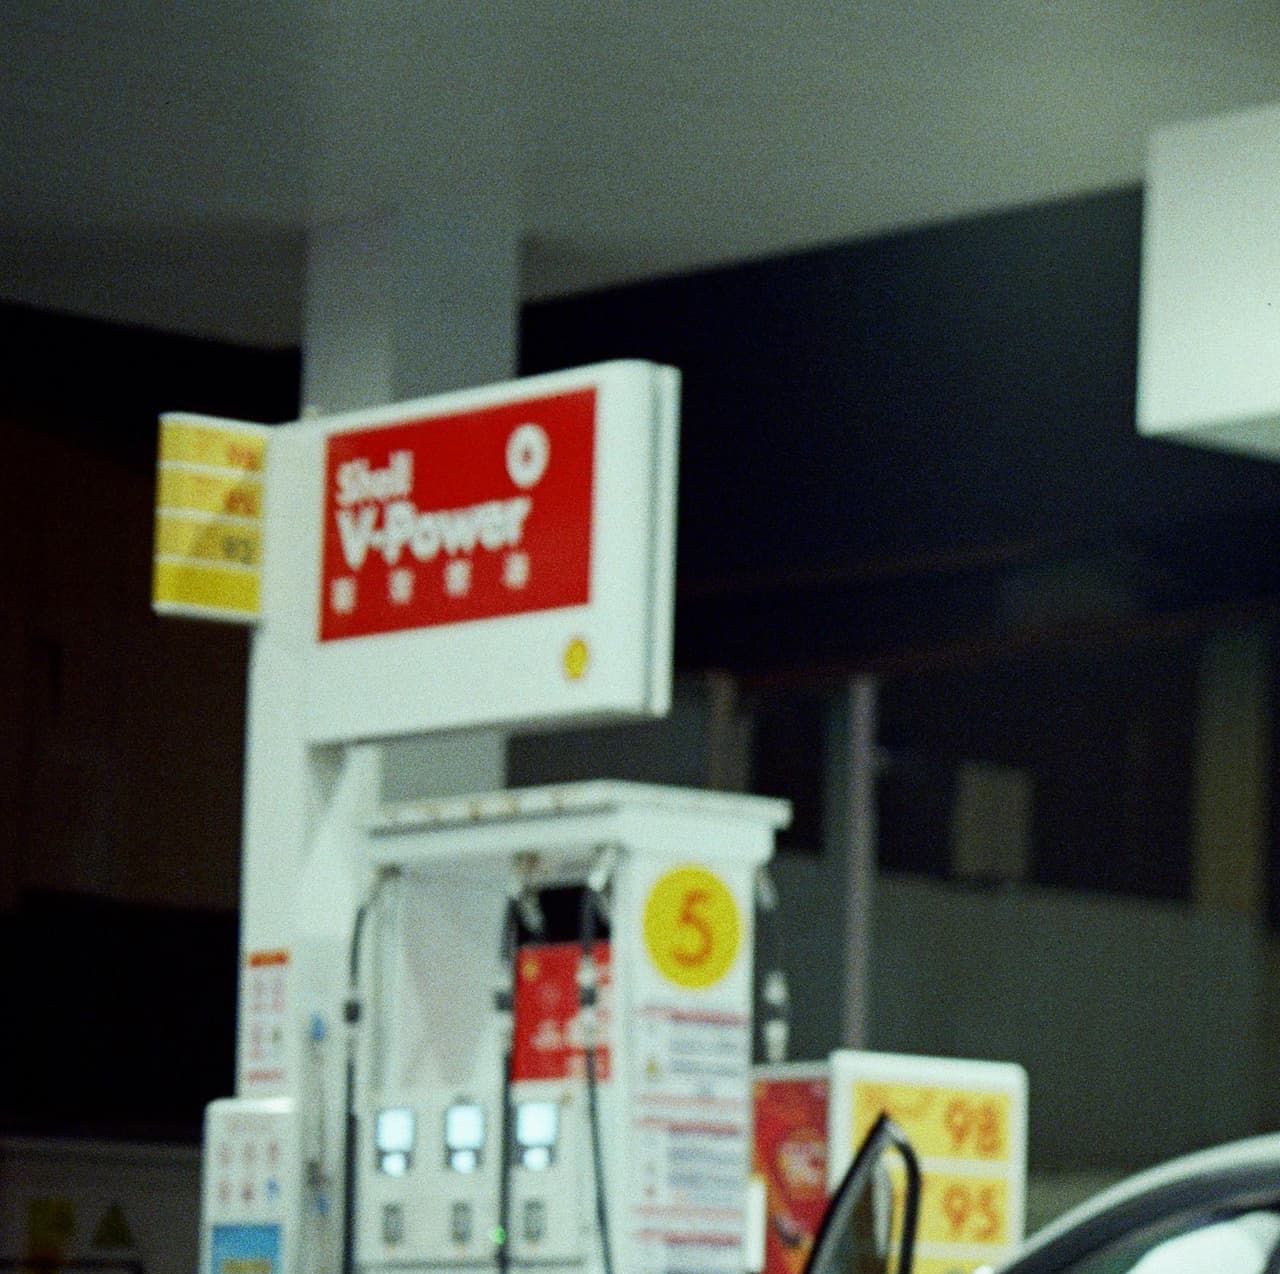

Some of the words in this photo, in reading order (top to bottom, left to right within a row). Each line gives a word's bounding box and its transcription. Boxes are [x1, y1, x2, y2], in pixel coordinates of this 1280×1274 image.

[336, 497, 532, 570] V-Power
[671, 889, 712, 967] 5
[942, 1183, 1001, 1243] 95
